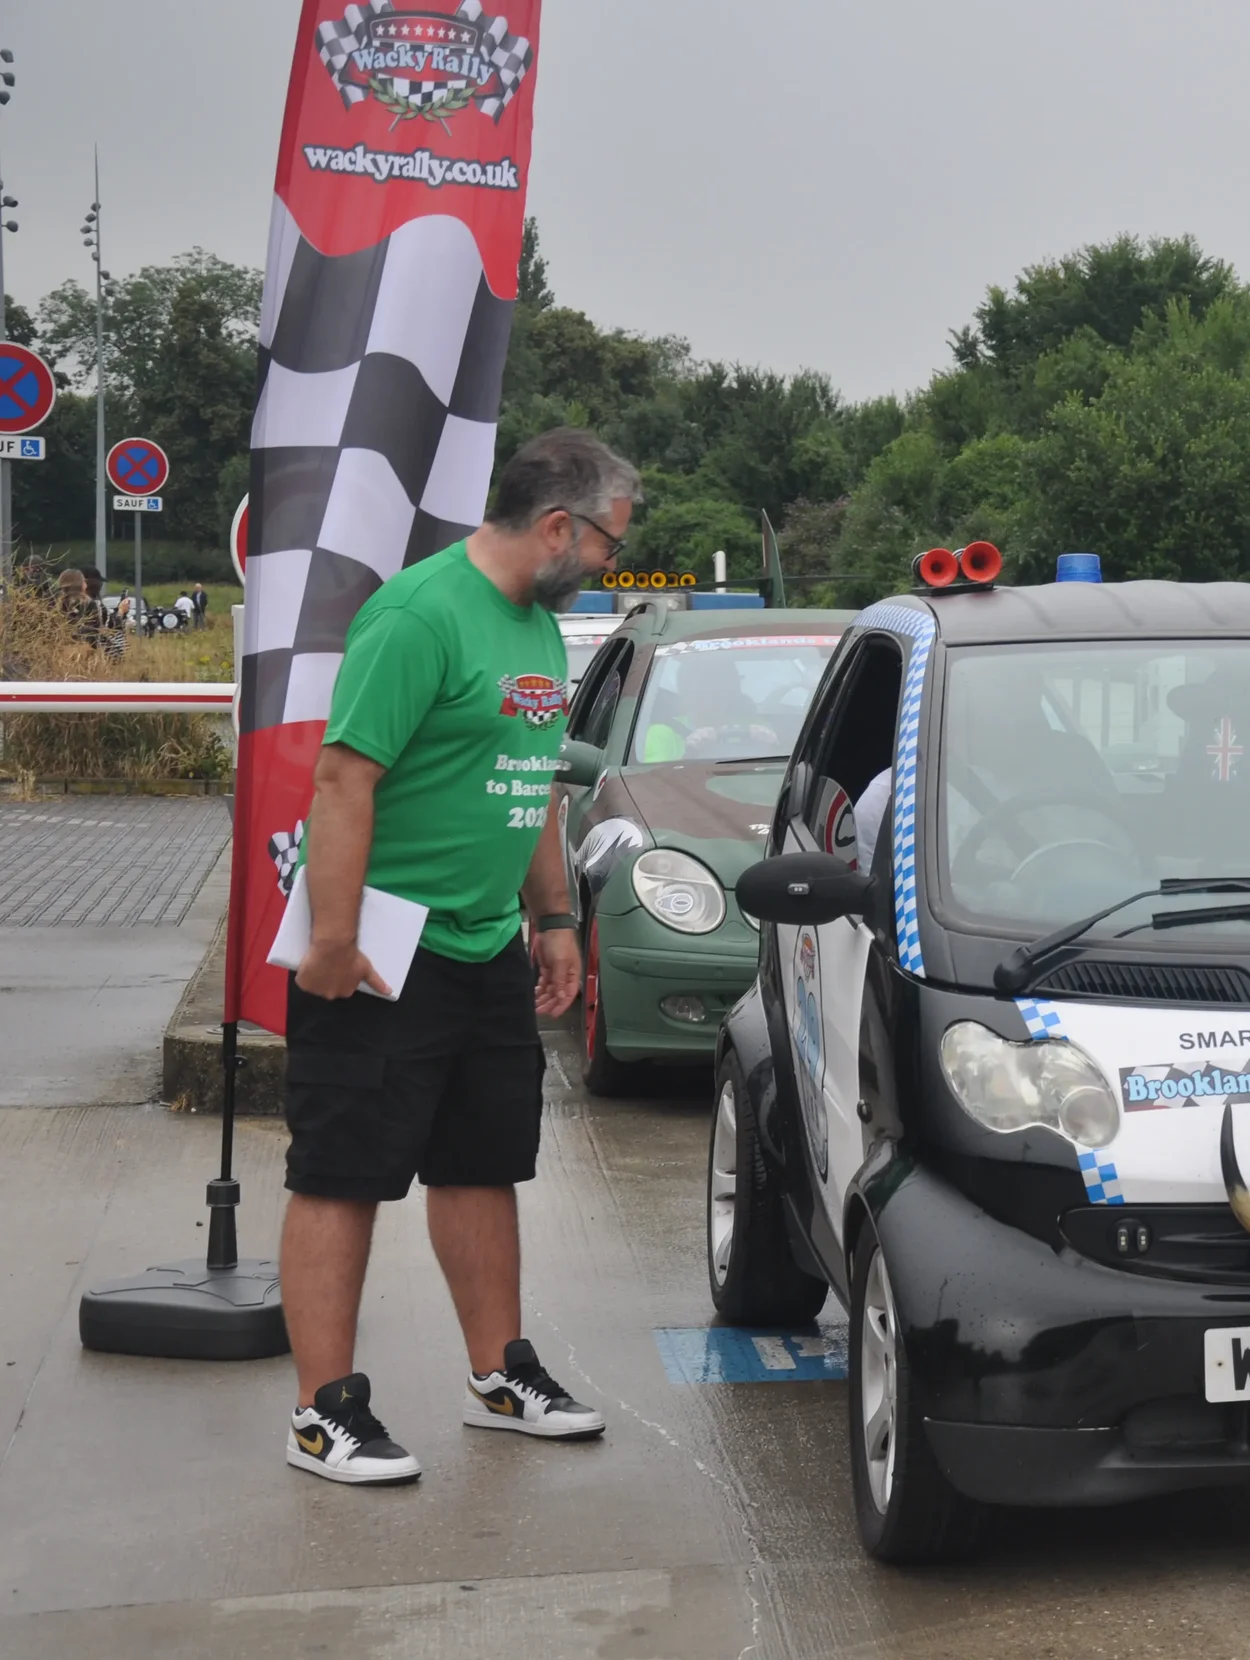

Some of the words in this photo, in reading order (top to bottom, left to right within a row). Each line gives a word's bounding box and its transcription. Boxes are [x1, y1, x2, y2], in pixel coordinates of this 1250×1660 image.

[352, 45, 430, 73] Wacky
[430, 47, 494, 86] Rally
[303, 144, 519, 189] wackyrally.co.uk
[117, 499, 144, 507] SAUF
[486, 779, 508, 795] to
